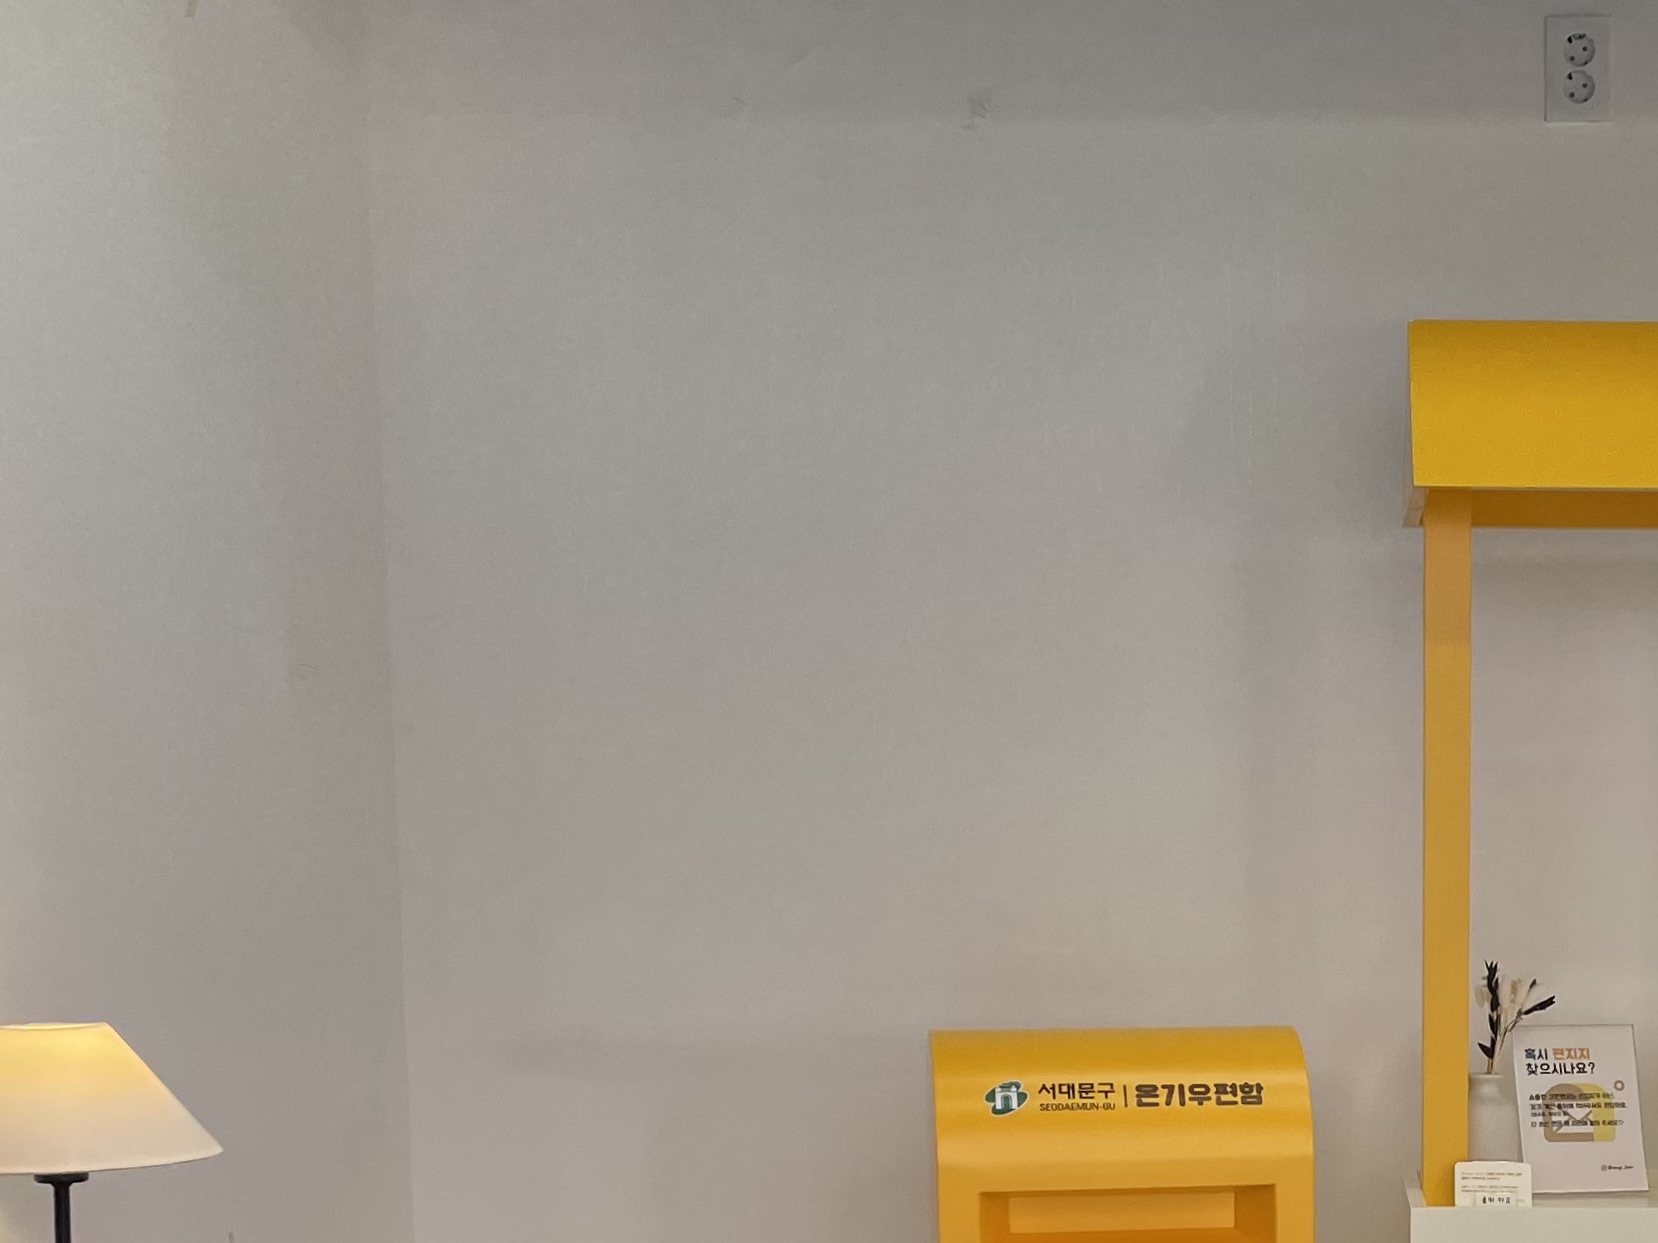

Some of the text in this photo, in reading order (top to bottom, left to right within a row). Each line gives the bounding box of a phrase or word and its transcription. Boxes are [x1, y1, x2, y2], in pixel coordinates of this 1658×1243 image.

[1524, 1048, 1590, 1060] 혹시 편지지
[1526, 1062, 1595, 1076] 찾으시나요?
[1037, 1082, 1264, 1107] 서대문구 온기우편함
[1039, 1102, 1116, 1112] SEODAEMUN-GU
